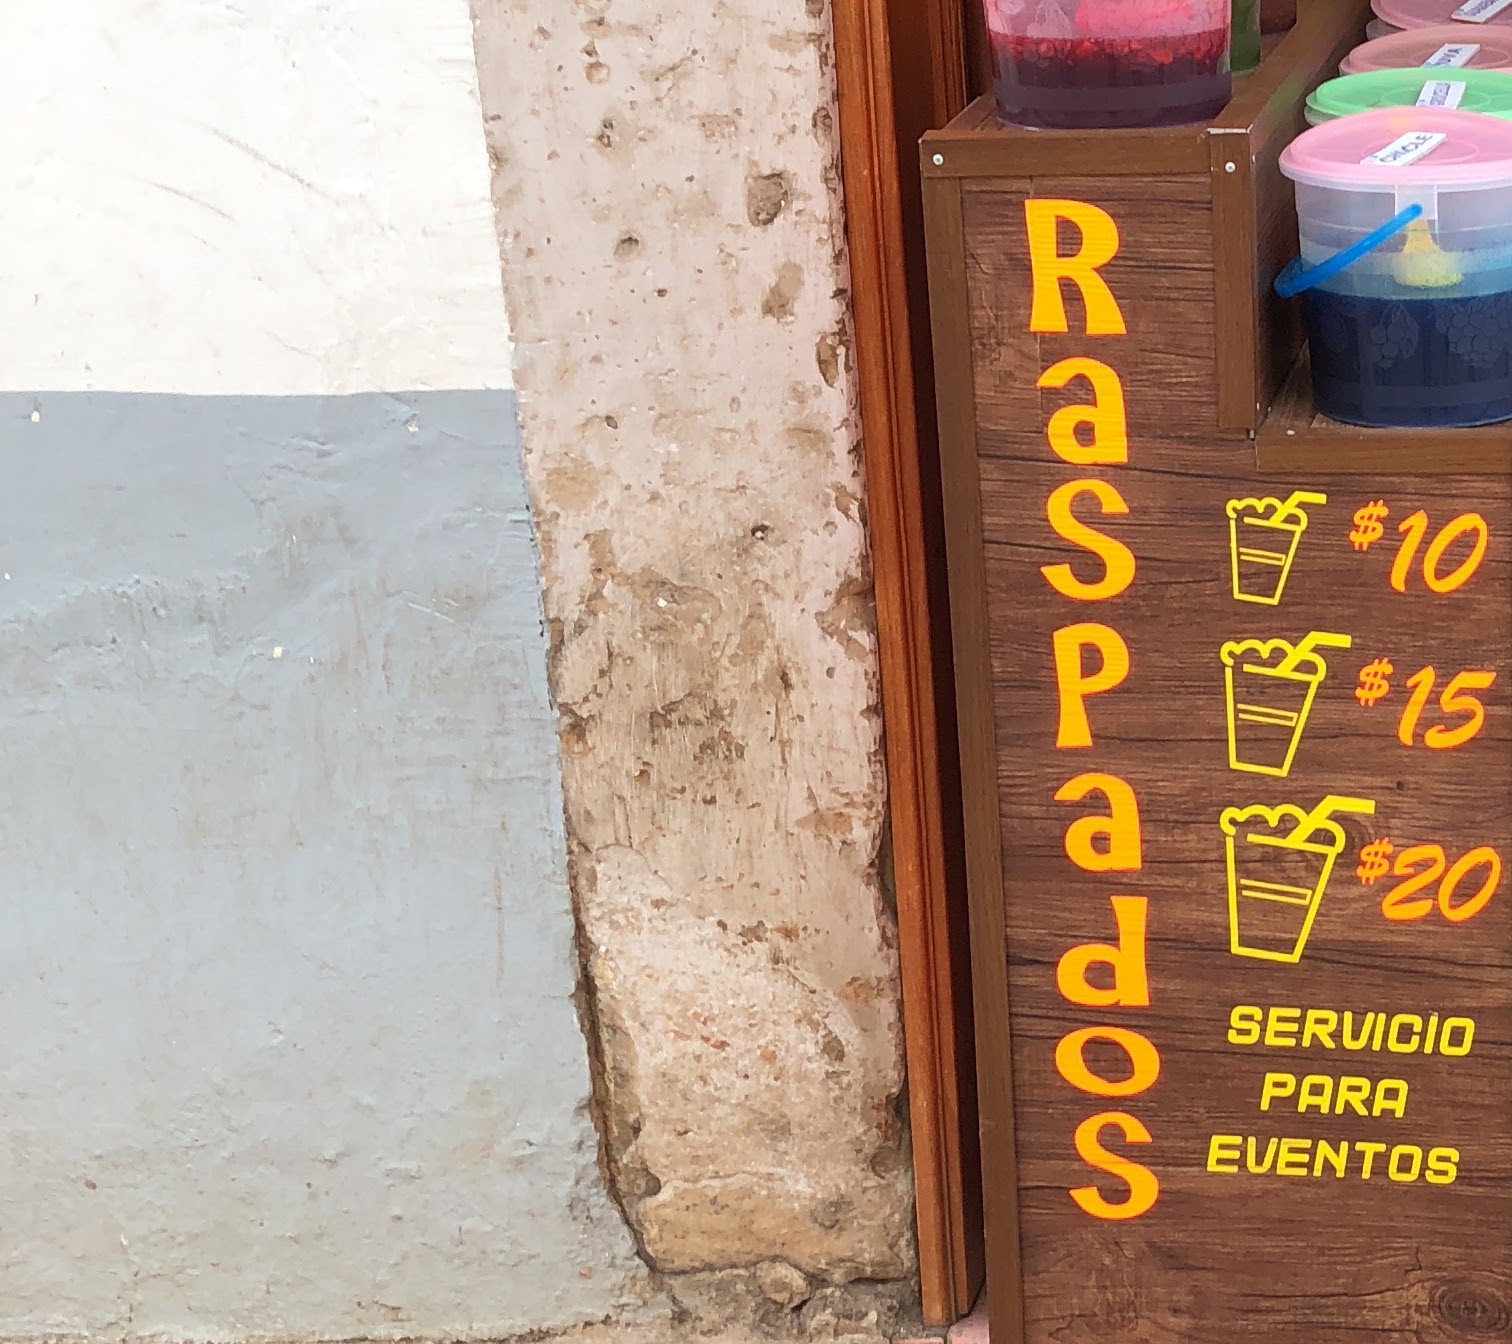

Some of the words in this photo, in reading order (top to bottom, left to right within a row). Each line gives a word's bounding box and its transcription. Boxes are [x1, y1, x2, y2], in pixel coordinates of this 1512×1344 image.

[1347, 499, 1489, 594] $10
[1355, 657, 1497, 750] $15
[1355, 838, 1502, 923] $20
[1226, 1005, 1476, 1057] SERVICIO
[1259, 1072, 1409, 1119] PARA
[1205, 1134, 1461, 1186] EVENTOS
